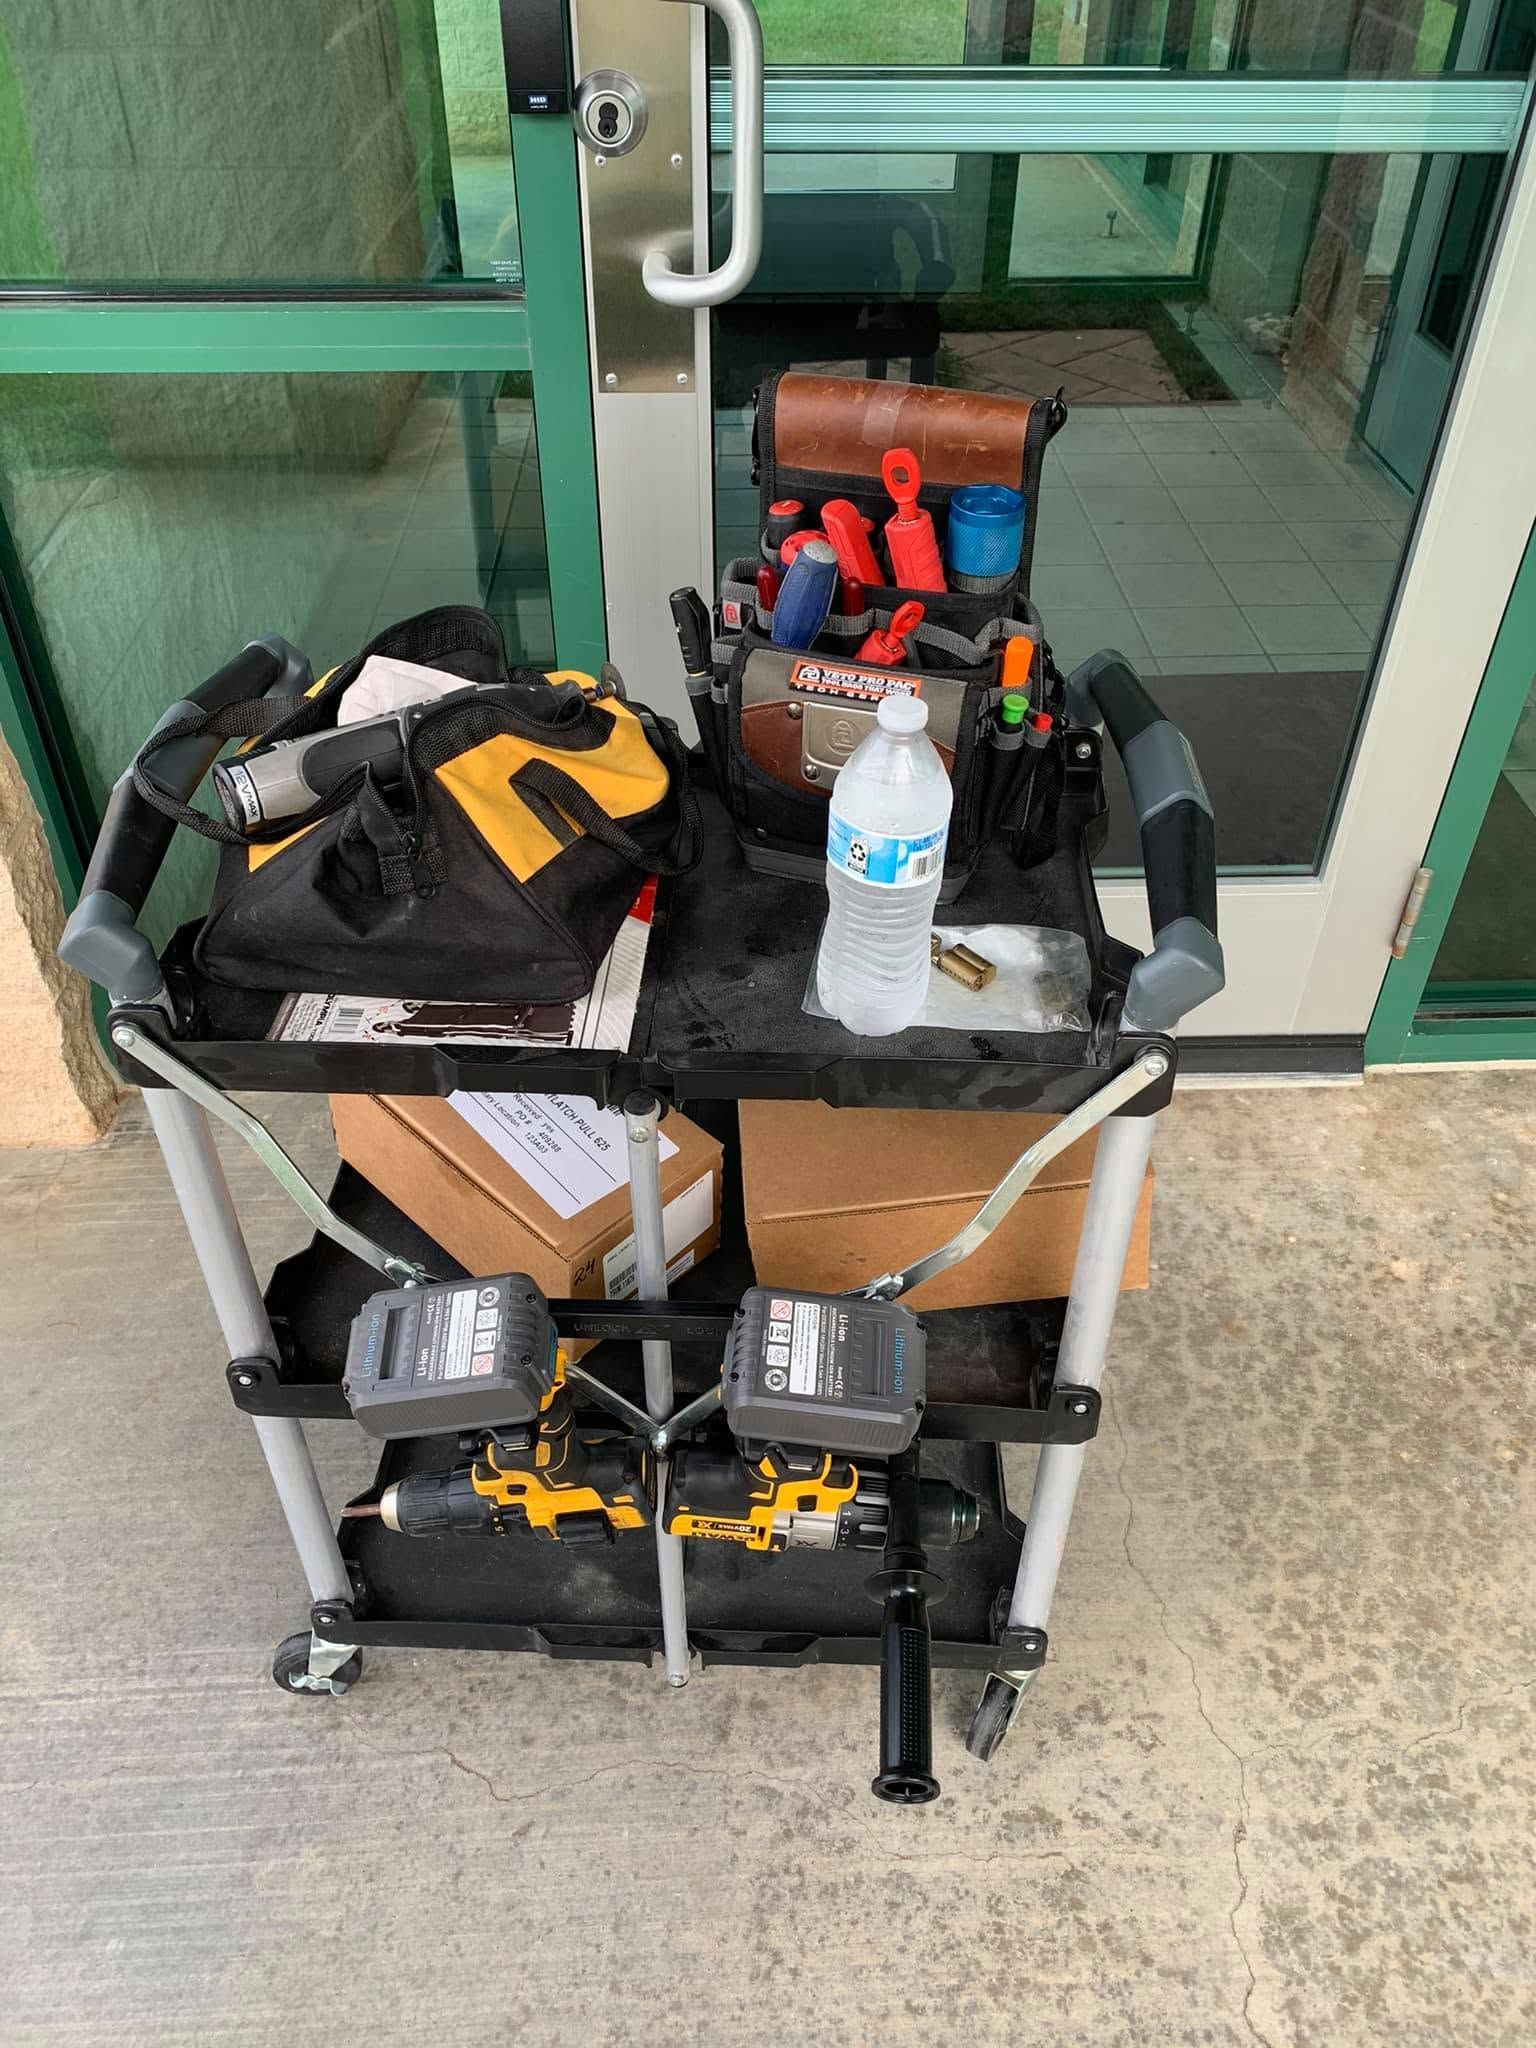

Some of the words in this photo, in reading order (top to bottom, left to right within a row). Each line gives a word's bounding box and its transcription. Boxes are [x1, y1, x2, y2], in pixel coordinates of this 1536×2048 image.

[529, 96, 547, 104] HID
[823, 669, 857, 682] VETO
[858, 674, 885, 686] PRO
[794, 683, 839, 696] TECH
[821, 677, 841, 687] TOOL
[841, 681, 864, 690] BAGS
[864, 684, 884, 693] THAT
[514, 1109, 527, 1120] PO
[541, 1121, 554, 1133] yes
[545, 1093, 579, 1121] TLATCH
[573, 1118, 596, 1140] PULL
[593, 1136, 612, 1152] 625
[894, 1327, 906, 1394] Lithium-ion
